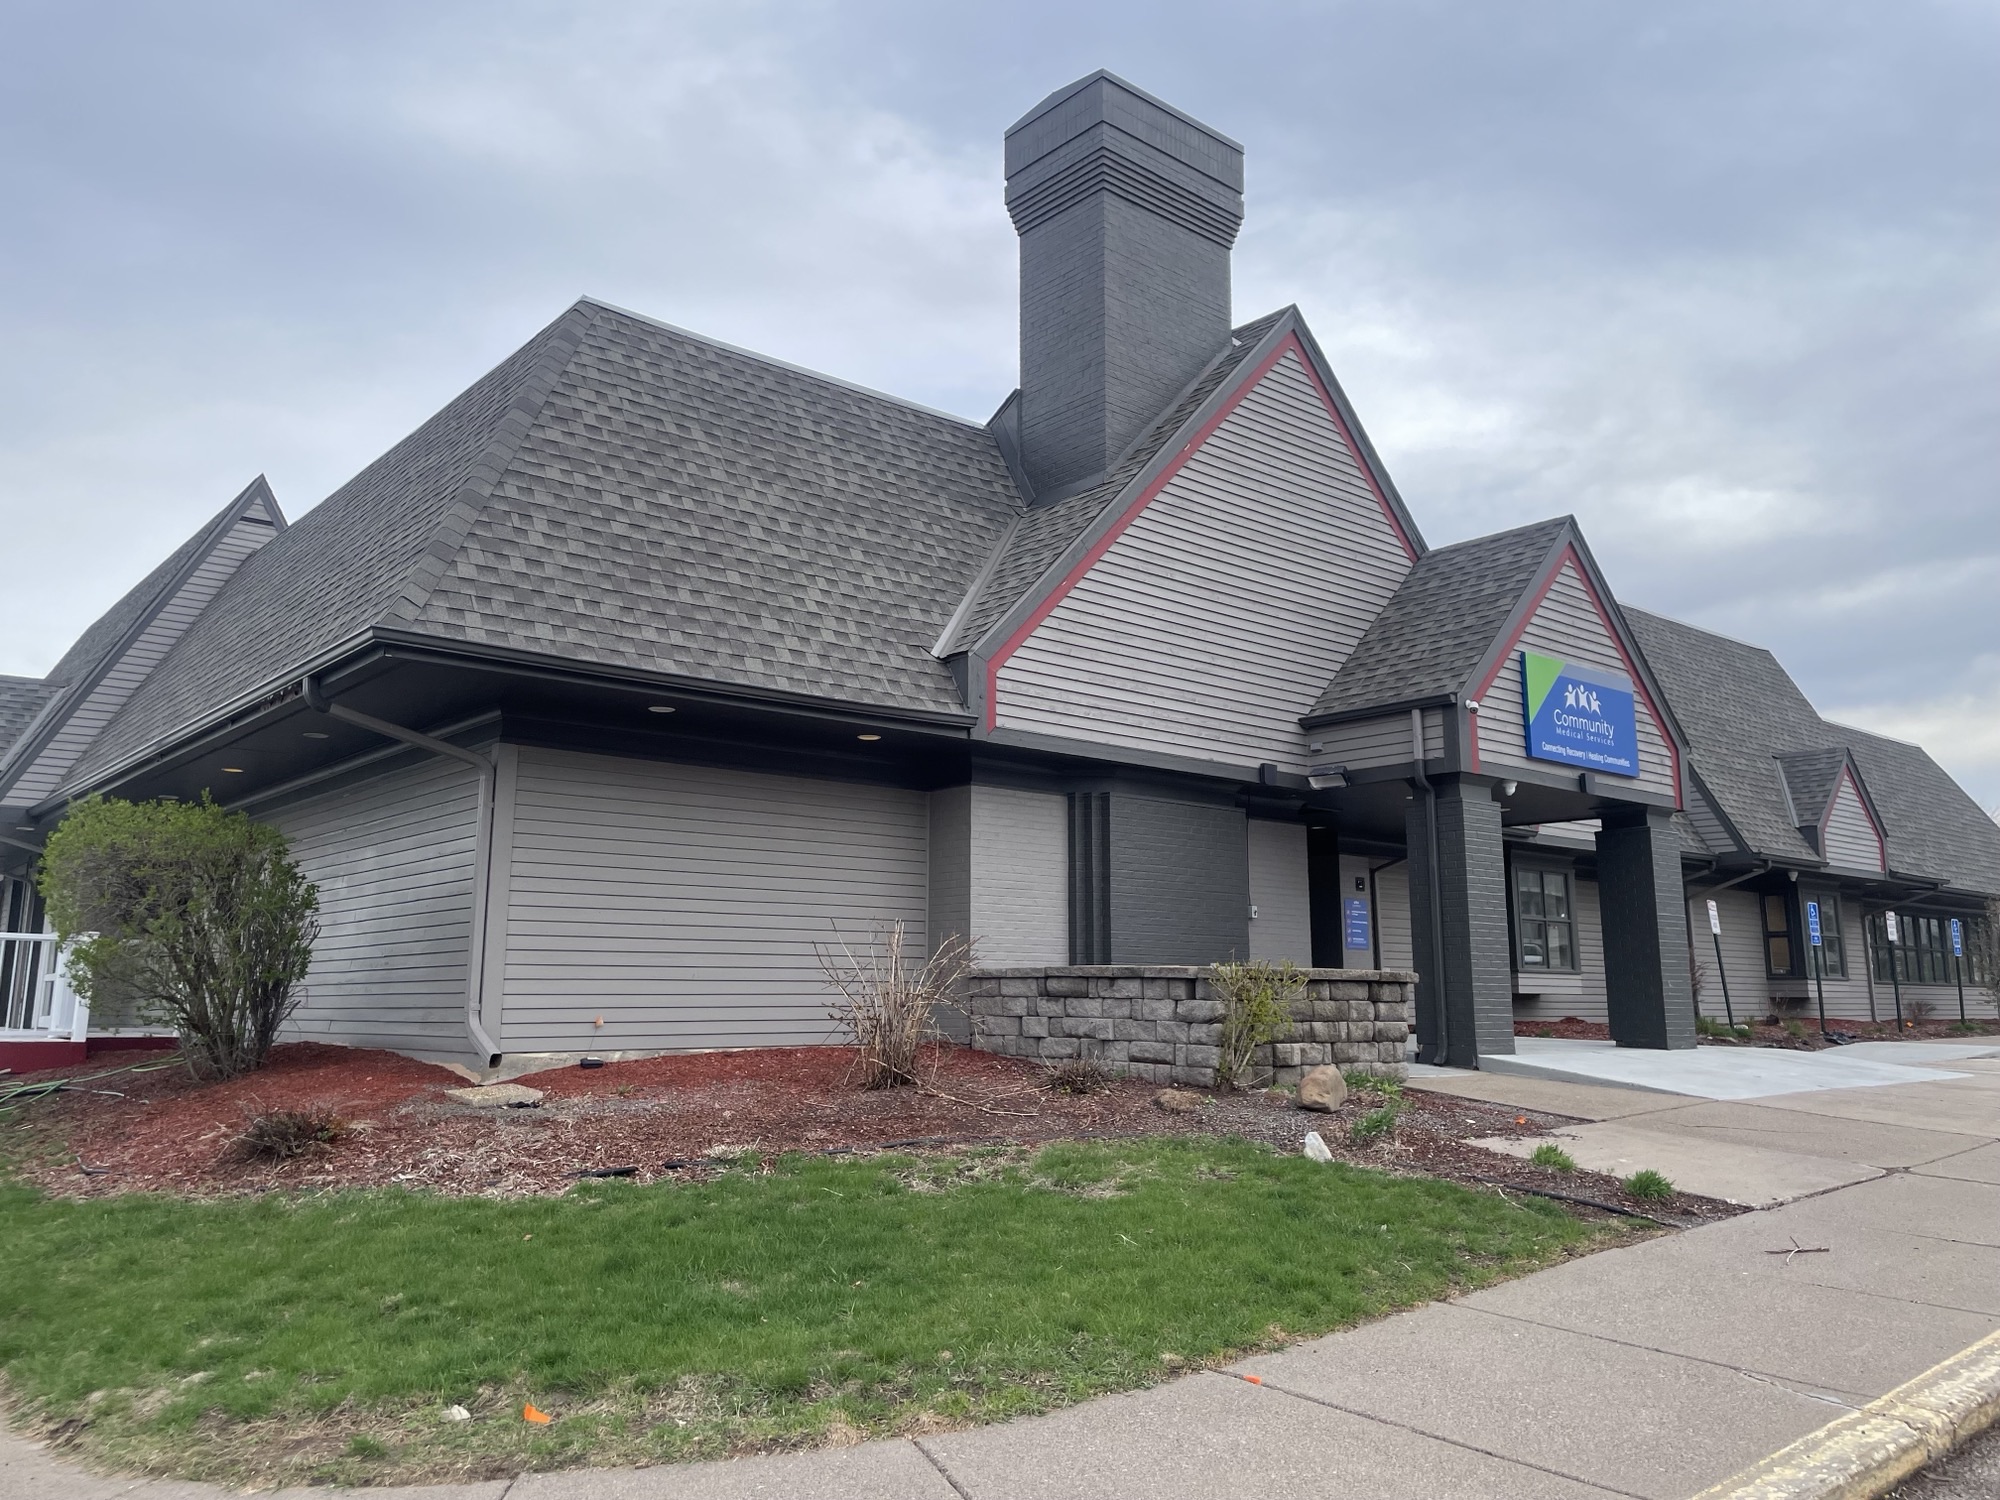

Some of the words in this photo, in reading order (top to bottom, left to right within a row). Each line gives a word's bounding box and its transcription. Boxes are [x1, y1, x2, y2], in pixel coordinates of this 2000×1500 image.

[1554, 708, 1614, 738] Community
[1556, 726, 1584, 739] Medical
[1586, 732, 1614, 746] Services
[1542, 741, 1566, 756] Connecting
[1566, 746, 1585, 760] Recovery
[1589, 751, 1604, 764] Healing
[1604, 754, 1630, 767] Communities
